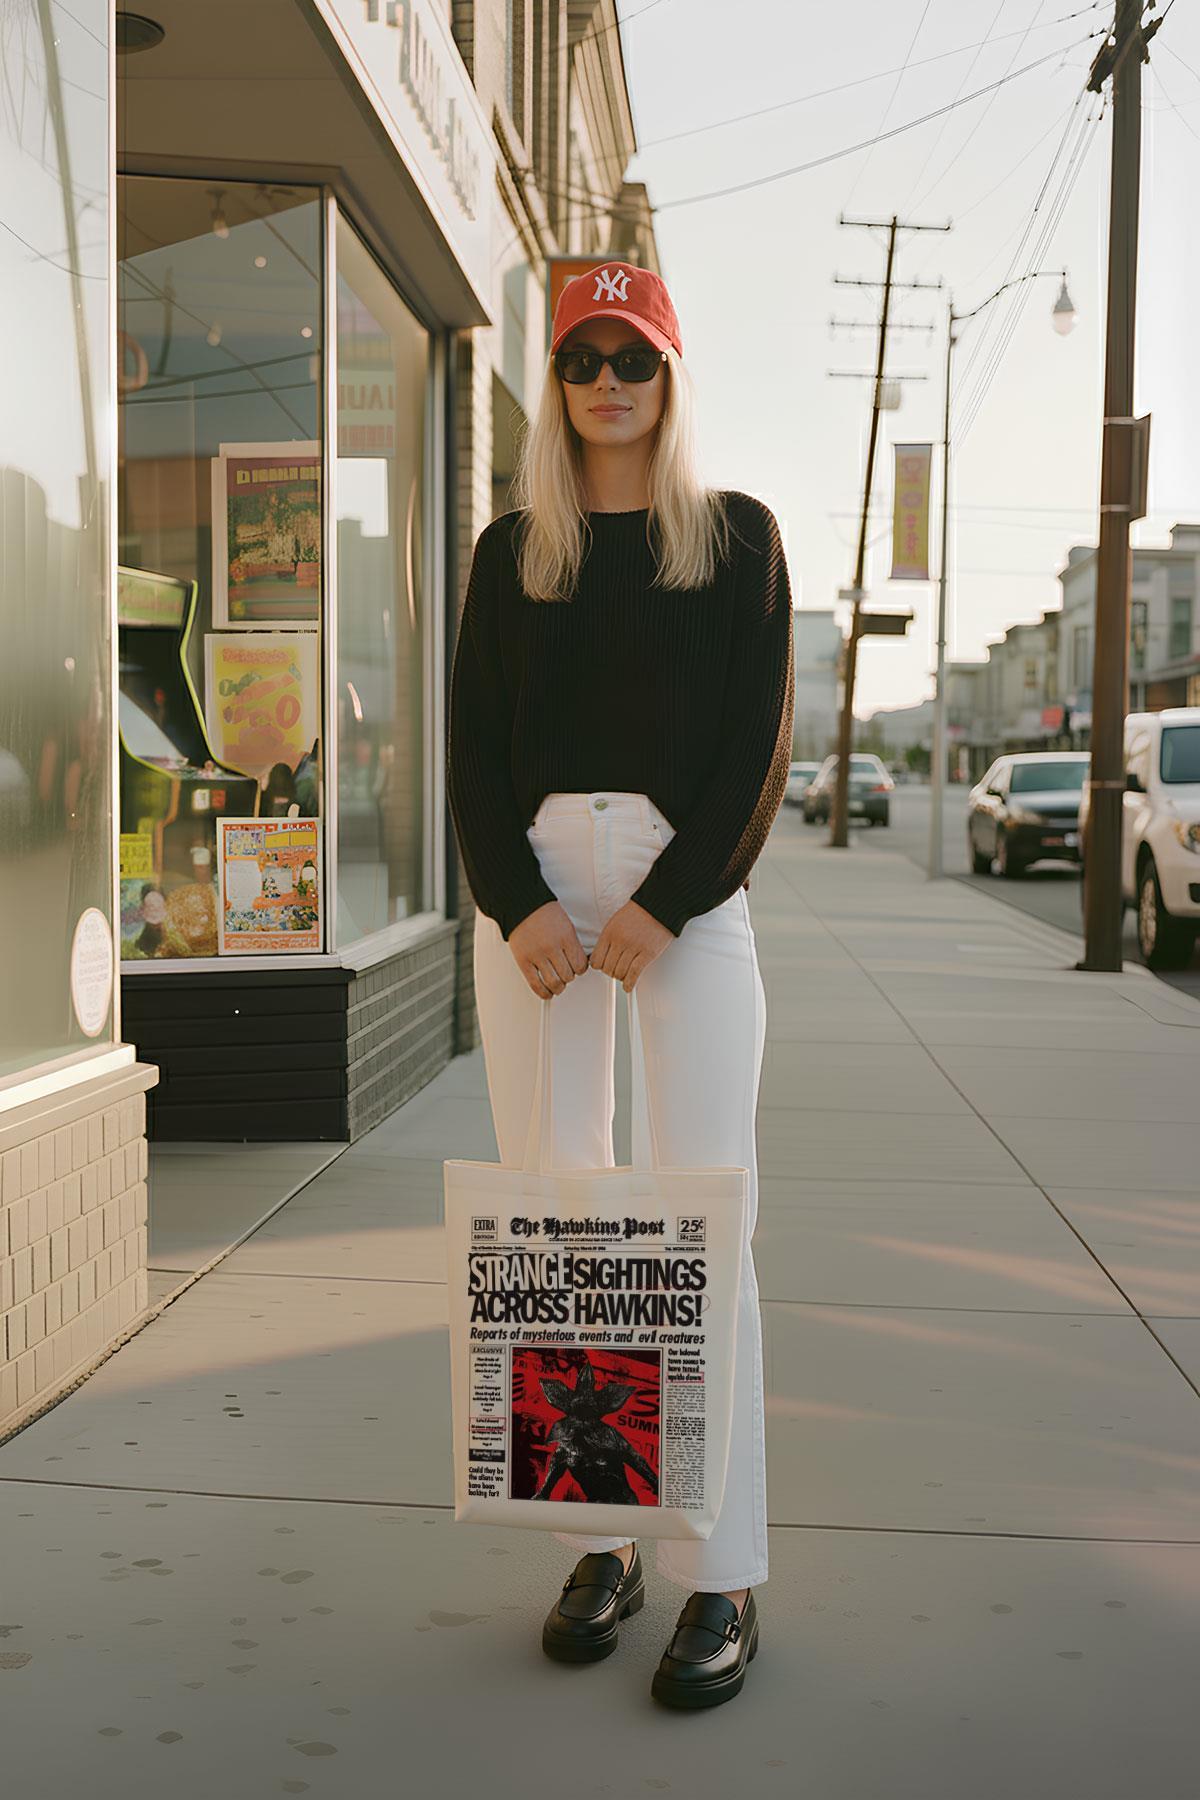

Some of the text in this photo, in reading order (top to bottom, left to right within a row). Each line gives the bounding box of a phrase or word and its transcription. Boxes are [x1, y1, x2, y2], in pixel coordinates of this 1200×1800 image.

[592, 270, 632, 302] NY
[474, 1220, 495, 1230] EXTRA
[510, 1217, 665, 1239] The Hawkins Post
[680, 1219, 704, 1232] 25¢
[470, 1253, 706, 1292] STRANGE SIGHTINGS
[470, 1292, 702, 1326] ACROSS HAWKINS!
[470, 1327, 705, 1344] Reports of mysterious events and evil creatures
